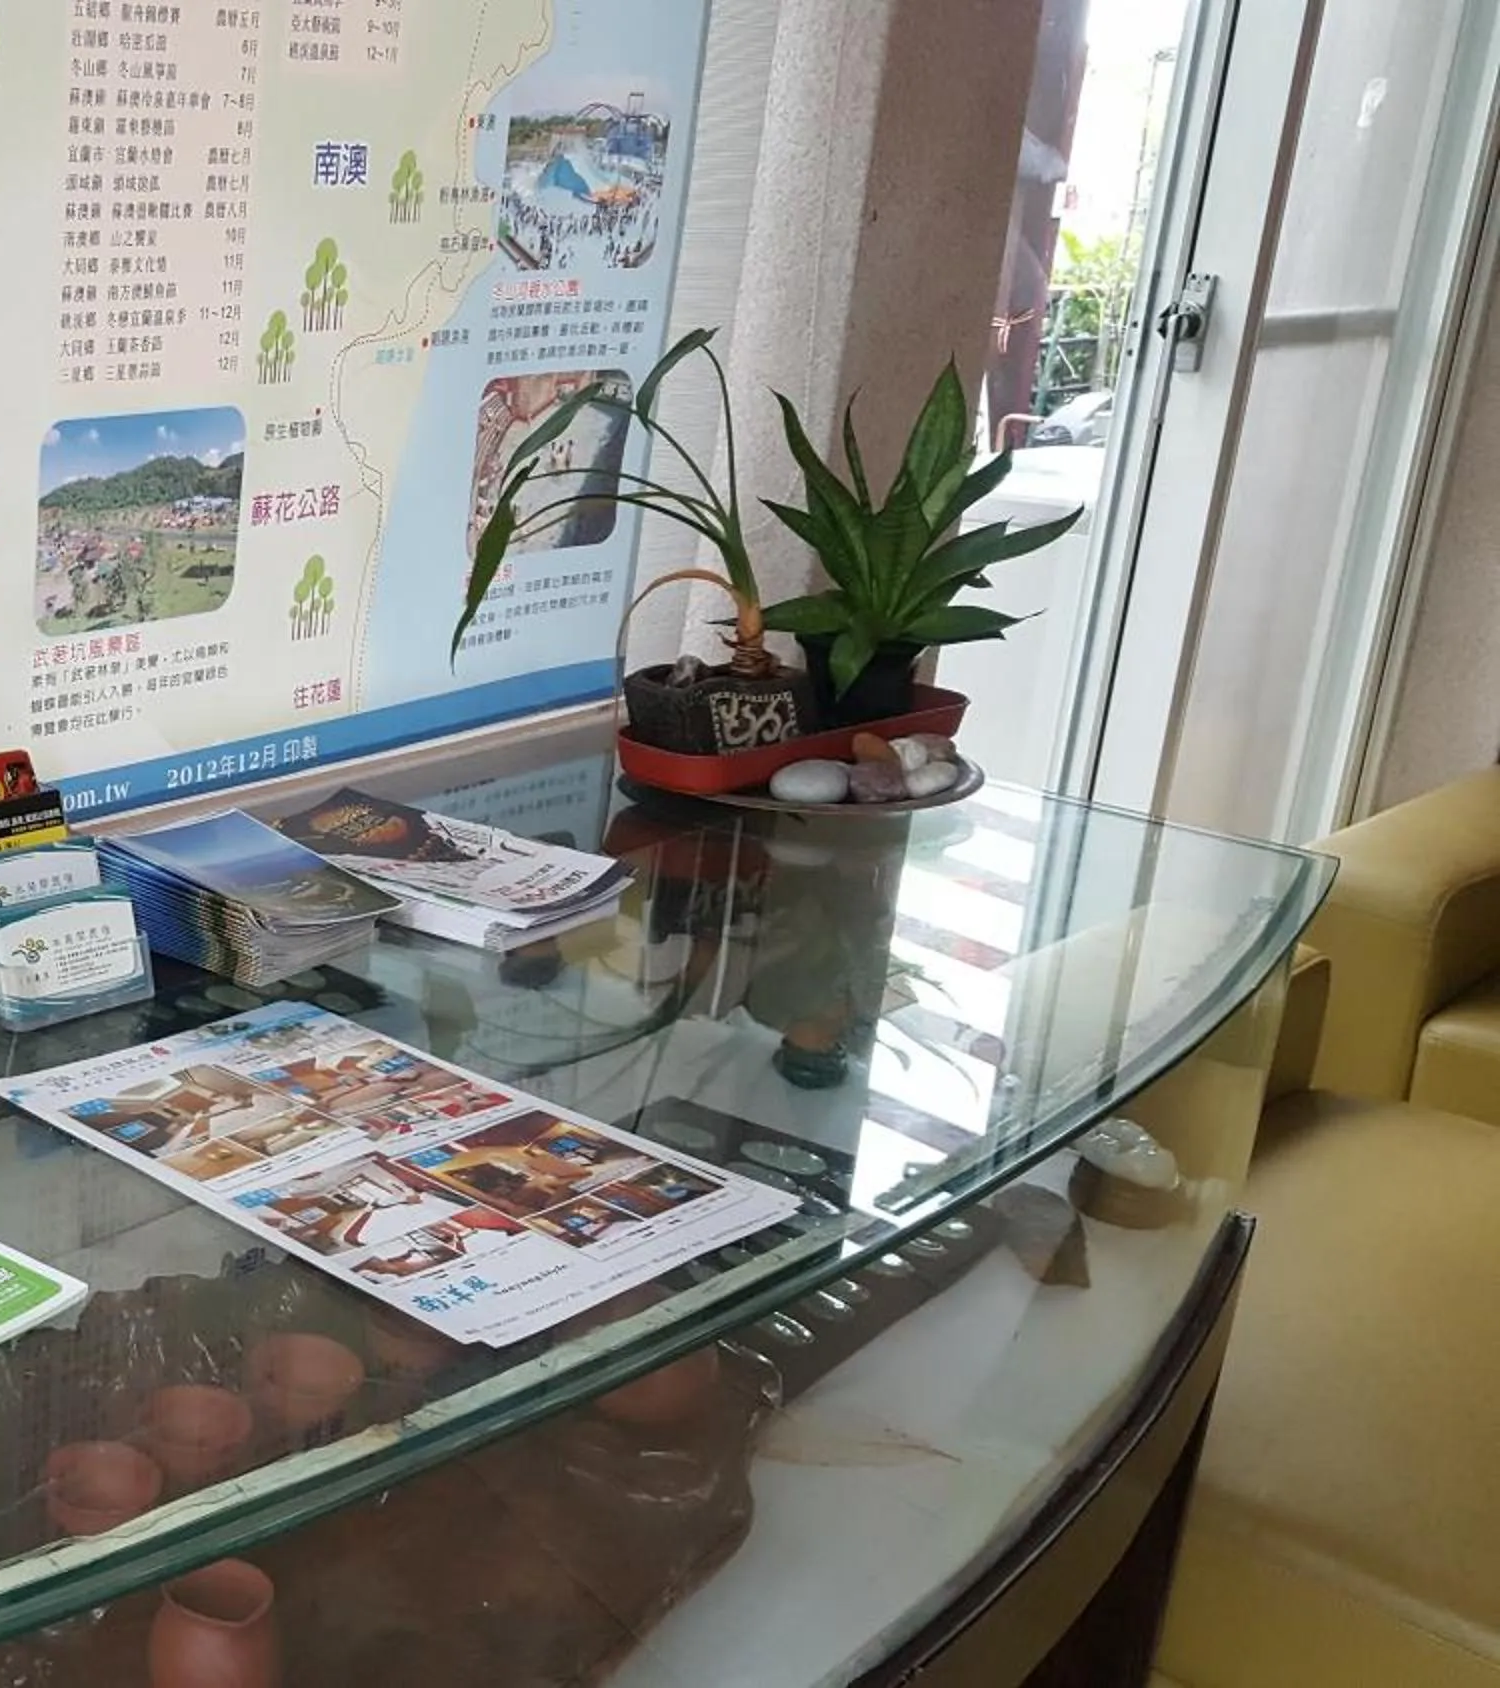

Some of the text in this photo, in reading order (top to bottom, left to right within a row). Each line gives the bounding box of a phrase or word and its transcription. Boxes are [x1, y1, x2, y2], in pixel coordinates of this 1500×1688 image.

[313, 142, 368, 186] 南澳
[251, 485, 340, 526] 蘇花公路
[293, 679, 342, 709] 往花蓮
[166, 735, 319, 789] 2012年12月 印製
